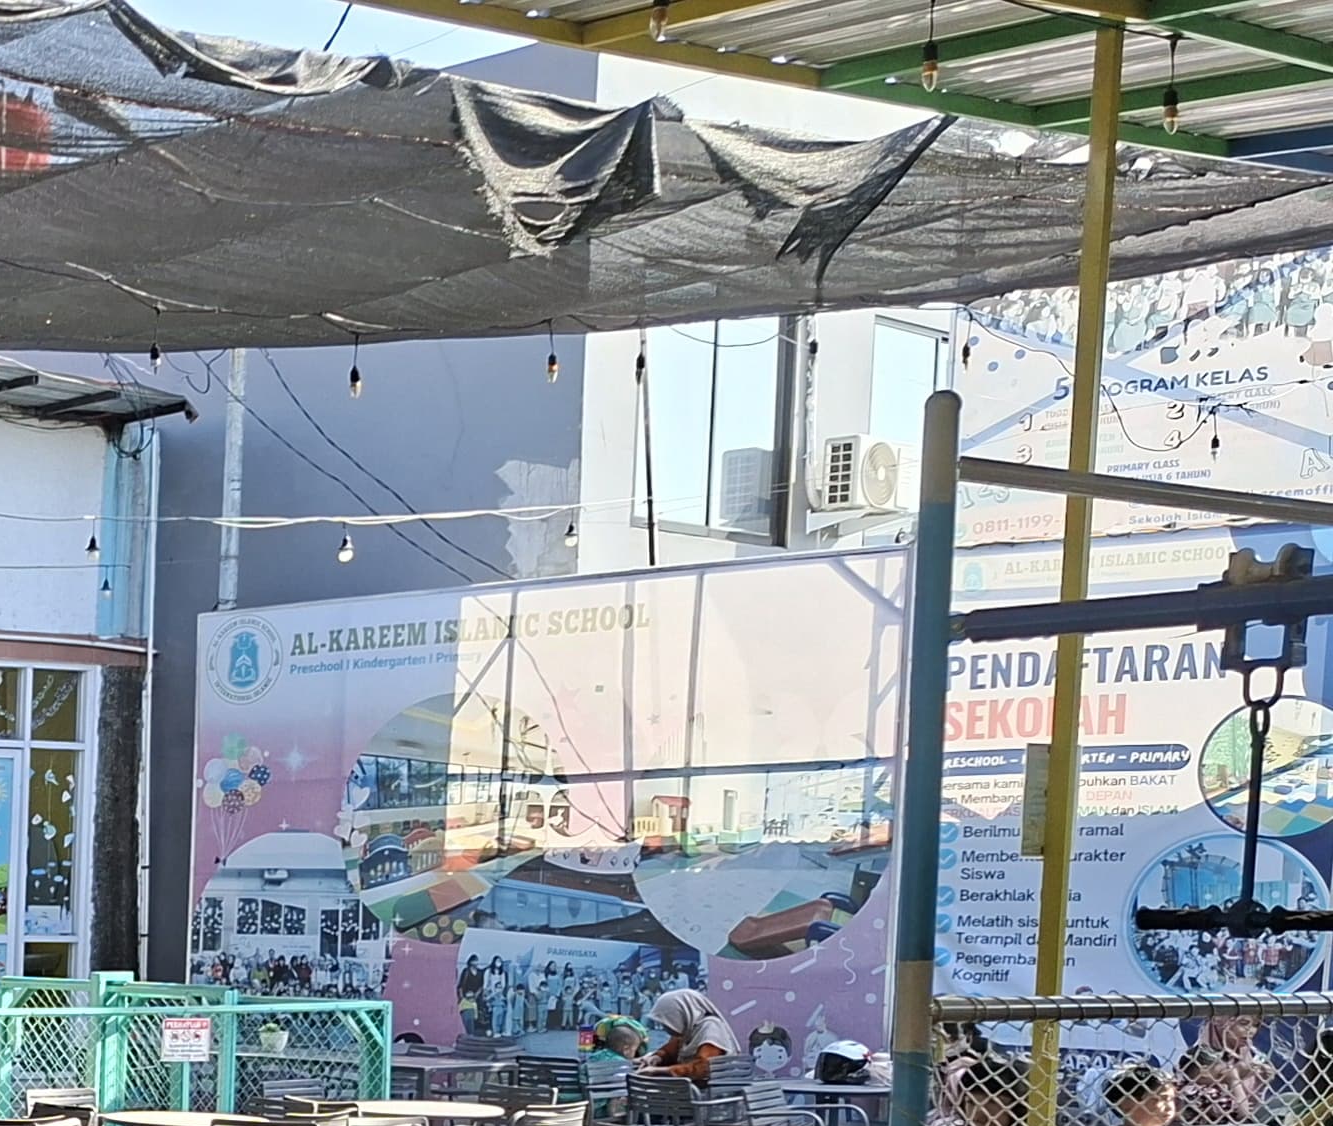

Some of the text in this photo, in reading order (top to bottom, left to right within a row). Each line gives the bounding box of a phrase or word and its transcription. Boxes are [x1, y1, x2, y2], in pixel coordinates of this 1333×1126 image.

[1053, 377, 1070, 400] 5
[1196, 366, 1269, 387] KELAS
[1107, 459, 1180, 473] PRIMARY CLASS
[1166, 471, 1172, 480] 6
[1129, 513, 1181, 525] Sekolah
[1099, 551, 1167, 568] ISLAMIC
[290, 603, 650, 656] AL-KAREEM ISLAMIC SCHOOL
[289, 659, 343, 674] Preschool
[352, 654, 425, 671] Kindergarten
[1130, 750, 1191, 764] PRIMARY
[1130, 774, 1176, 786] BAKAT
[1086, 790, 1133, 801] DEPAN
[1112, 805, 1135, 816] dan
[963, 826, 1020, 838] Berilmu
[960, 868, 1005, 880] Siswa
[960, 889, 1035, 901] Berakhlak
[957, 916, 1013, 928] Melatih
[956, 932, 1022, 947] Terampil
[951, 968, 1010, 984] Kognitif
